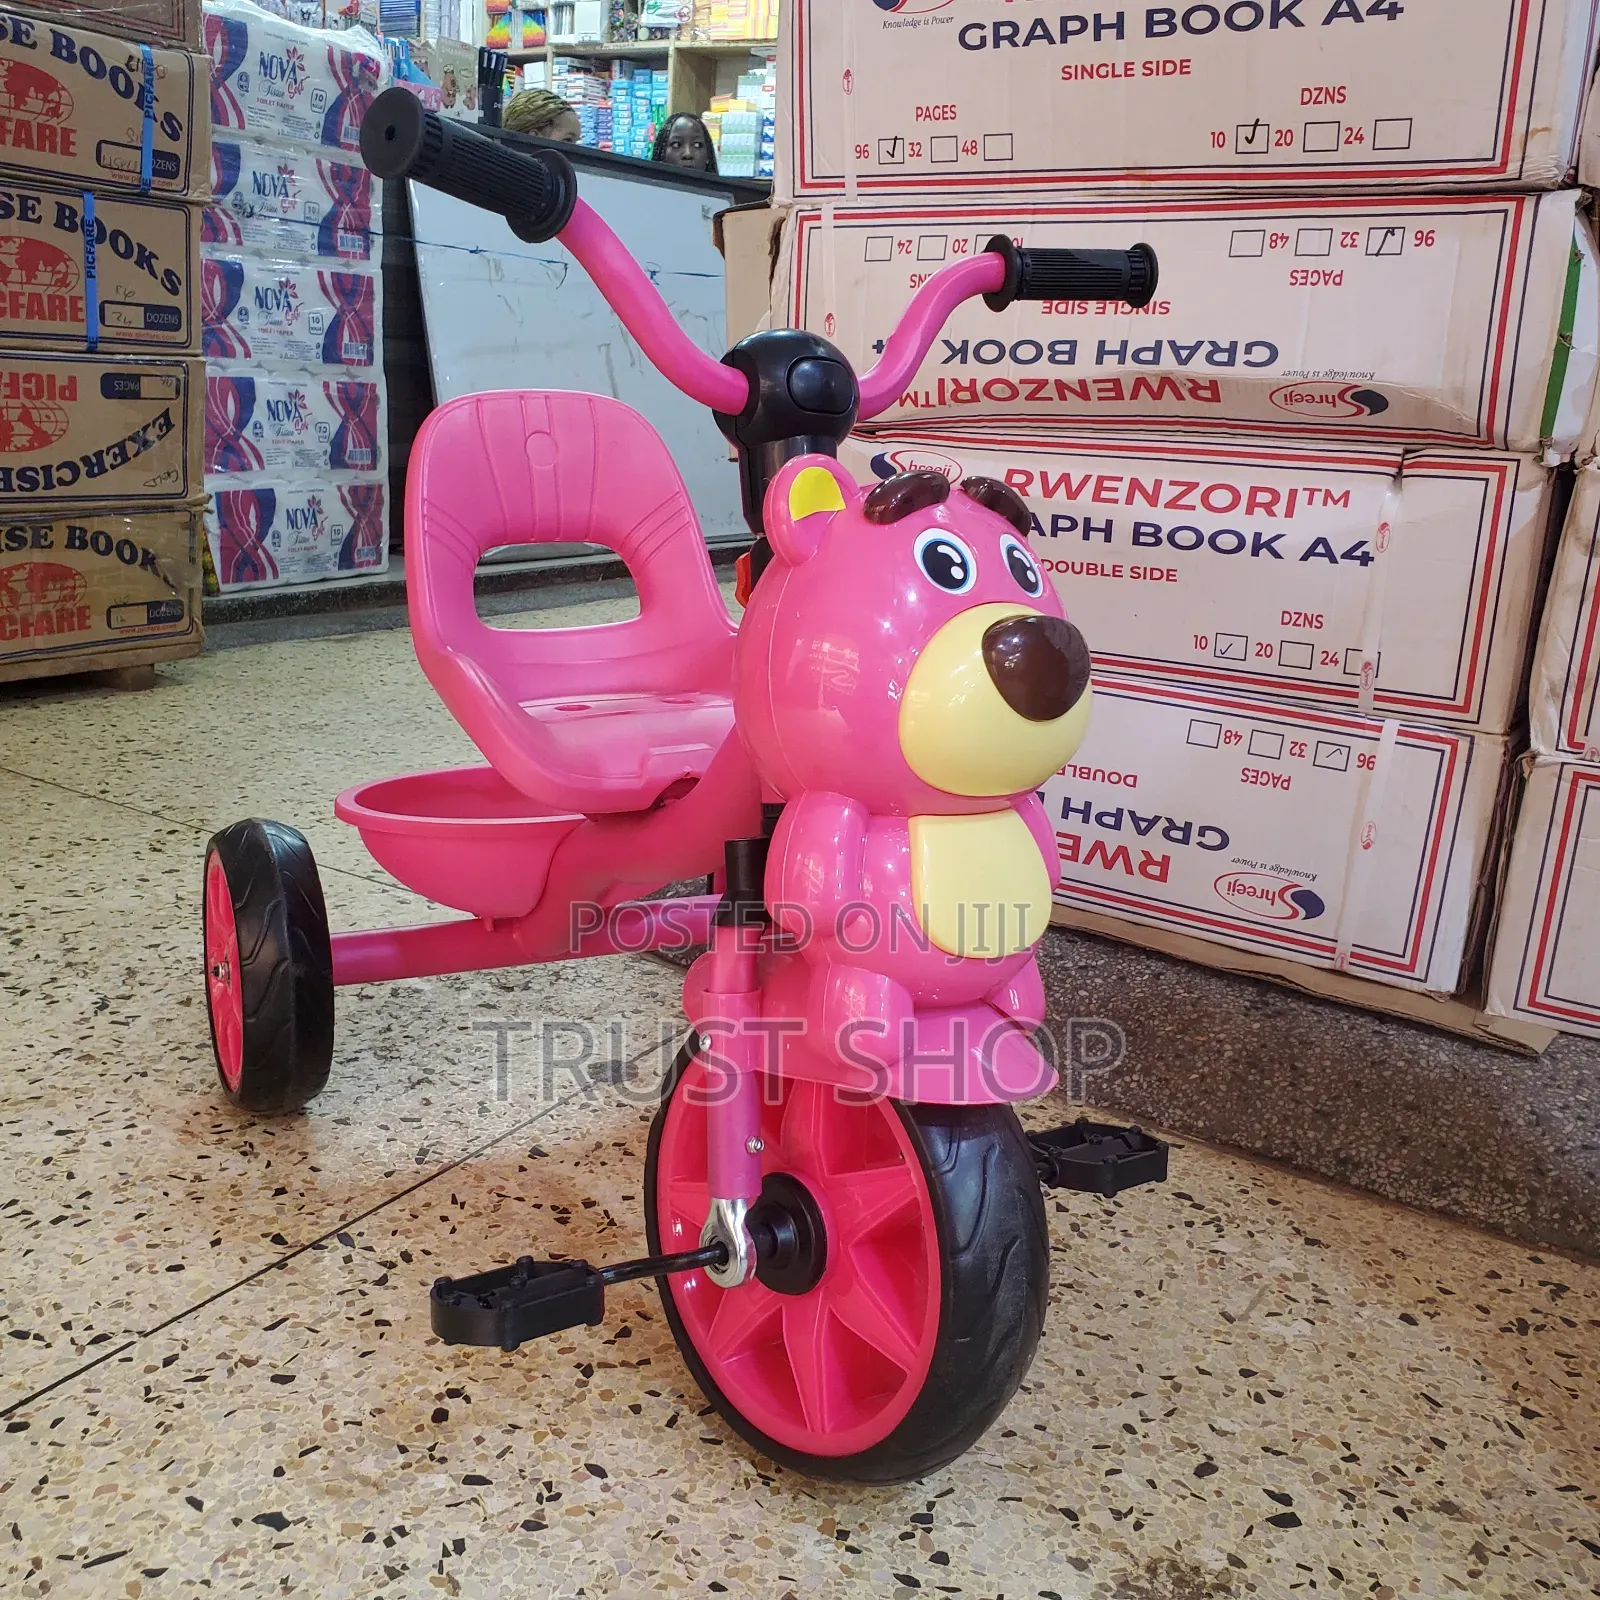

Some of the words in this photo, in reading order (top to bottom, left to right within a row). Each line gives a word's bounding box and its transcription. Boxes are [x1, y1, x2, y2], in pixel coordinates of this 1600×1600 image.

[882, 17, 922, 30] Knowledge
[923, 16, 930, 26] is
[931, 15, 954, 26] Power
[958, 11, 1125, 51] GRAPH
[1145, 0, 1306, 38] BOOK
[1321, 0, 1404, 25] A4
[259, 51, 298, 86] NOVA
[1061, 61, 1135, 81] SINGLE
[1141, 58, 1192, 77] SIDE
[143, 56, 155, 120] PICFARE
[314, 92, 324, 102] 10
[1300, 85, 1347, 106] DZNS
[915, 104, 957, 122] PAGES
[0, 115, 77, 157] FARE
[1210, 131, 1226, 148] 10
[1274, 130, 1294, 147] 20
[1343, 127, 1365, 145] 24
[854, 144, 870, 159] 96
[908, 142, 922, 157] 32
[961, 140, 978, 156] 48
[253, 170, 289, 198] NOVA
[896, 239, 913, 255] 24
[952, 238, 969, 254] 20
[1268, 231, 1290, 249] 48
[1340, 231, 1359, 248] 32
[1413, 229, 1436, 248] 96
[84, 218, 96, 280] PICFARE
[1289, 268, 1344, 287] PAGES
[254, 286, 293, 312] NOVA
[1041, 300, 1089, 316] SIDE
[1095, 300, 1171, 316] SINGLE
[146, 311, 180, 325] DOZENS
[311, 315, 321, 325] 10
[940, 338, 1077, 366] BOOK
[1095, 338, 1279, 368] GRAPH
[1281, 369, 1310, 379] Power
[1312, 369, 1321, 378] is
[1322, 369, 1376, 381] Knowledge
[0, 371, 78, 402] PICF
[114, 379, 140, 392] PAGES
[266, 398, 303, 423] NOVA
[1283, 384, 1364, 417] Shreeji
[0, 407, 176, 492] EXERCISE
[286, 507, 318, 530] NOVA
[1030, 511, 1114, 544] APH
[1131, 521, 1288, 560] BOOK
[1299, 536, 1375, 568] A4
[1040, 558, 1124, 578] DOUBLE
[1129, 565, 1178, 583] SIDE
[150, 605, 183, 618] DOZENS
[1280, 610, 1324, 630] DZNS
[0, 605, 91, 641] CFARE
[1193, 634, 1208, 651] 10
[1255, 642, 1273, 659] 20
[1320, 650, 1339, 668] 24
[1223, 729, 1244, 746] 48
[1289, 740, 1308, 758] 32
[1356, 752, 1376, 771] 96
[1240, 767, 1291, 791] PAGES
[1061, 796, 1230, 851] GRAPH
[1056, 831, 1171, 884] RWE
[1231, 857, 1258, 869] Power
[1259, 862, 1267, 870] is
[1268, 864, 1318, 882] Knowledge
[1227, 878, 1303, 920] Shreeji
